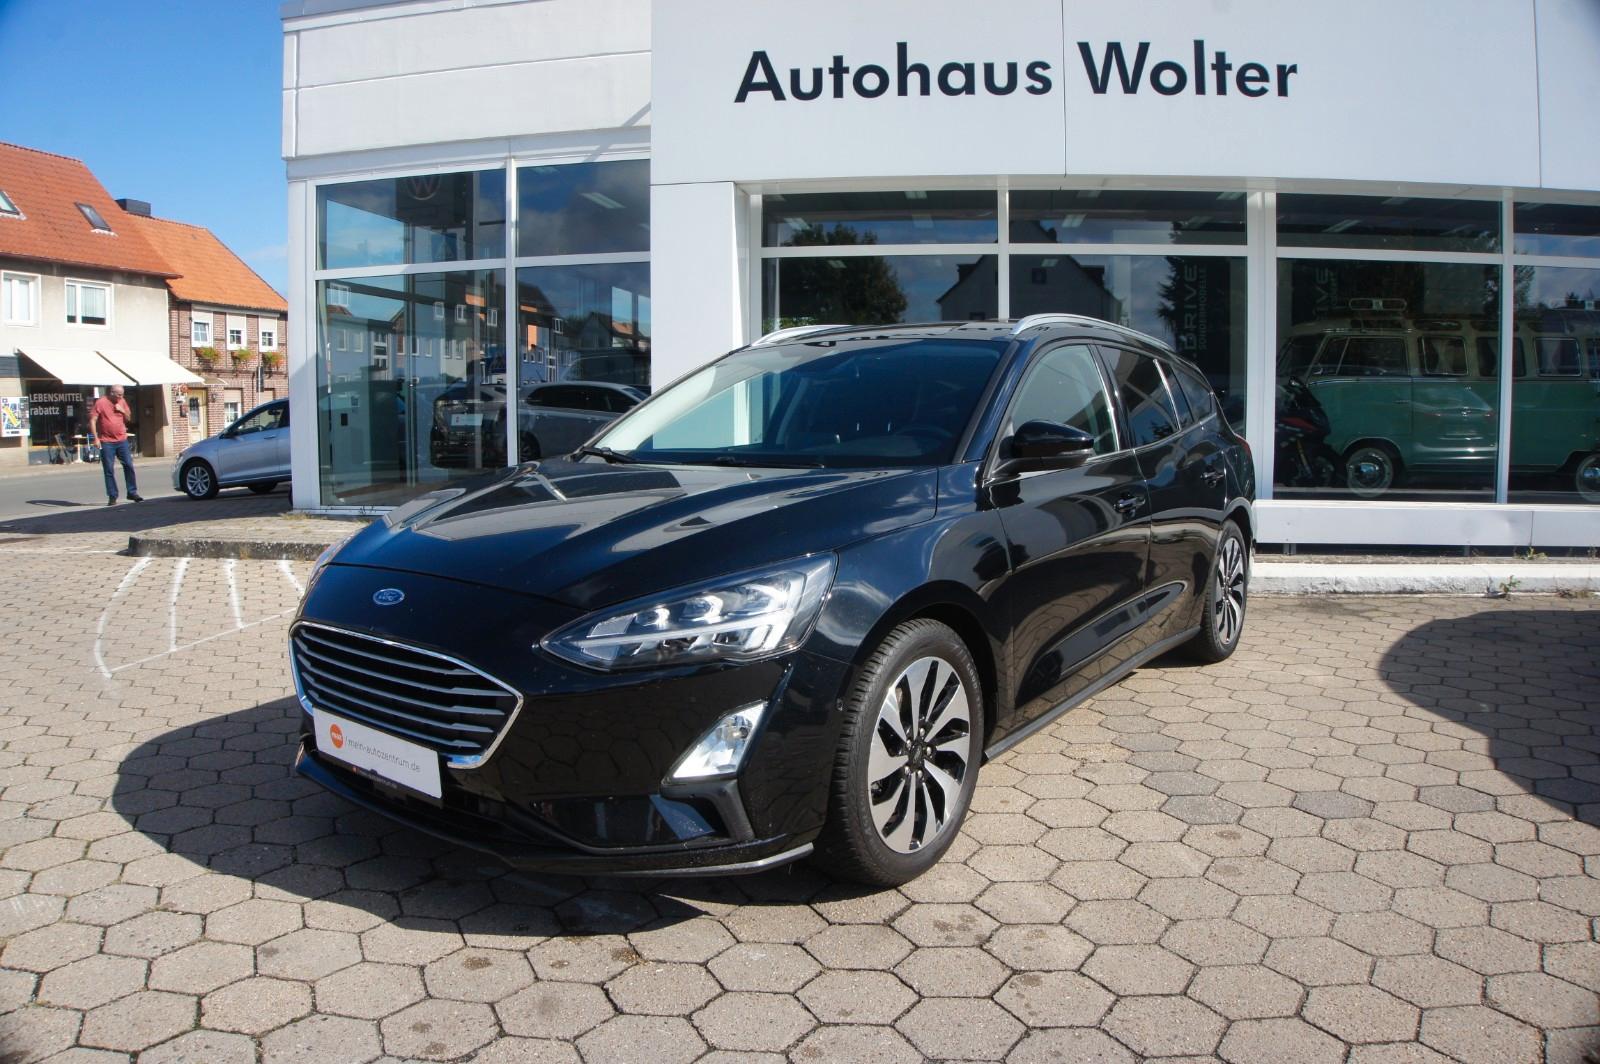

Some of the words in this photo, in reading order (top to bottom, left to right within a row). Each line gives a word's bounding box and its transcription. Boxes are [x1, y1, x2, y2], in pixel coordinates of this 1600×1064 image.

[734, 41, 1053, 103] Autohaus
[1077, 39, 1298, 98] Wolter
[29, 393, 84, 402] LEBENSMITTEL
[30, 406, 60, 415] rabattz
